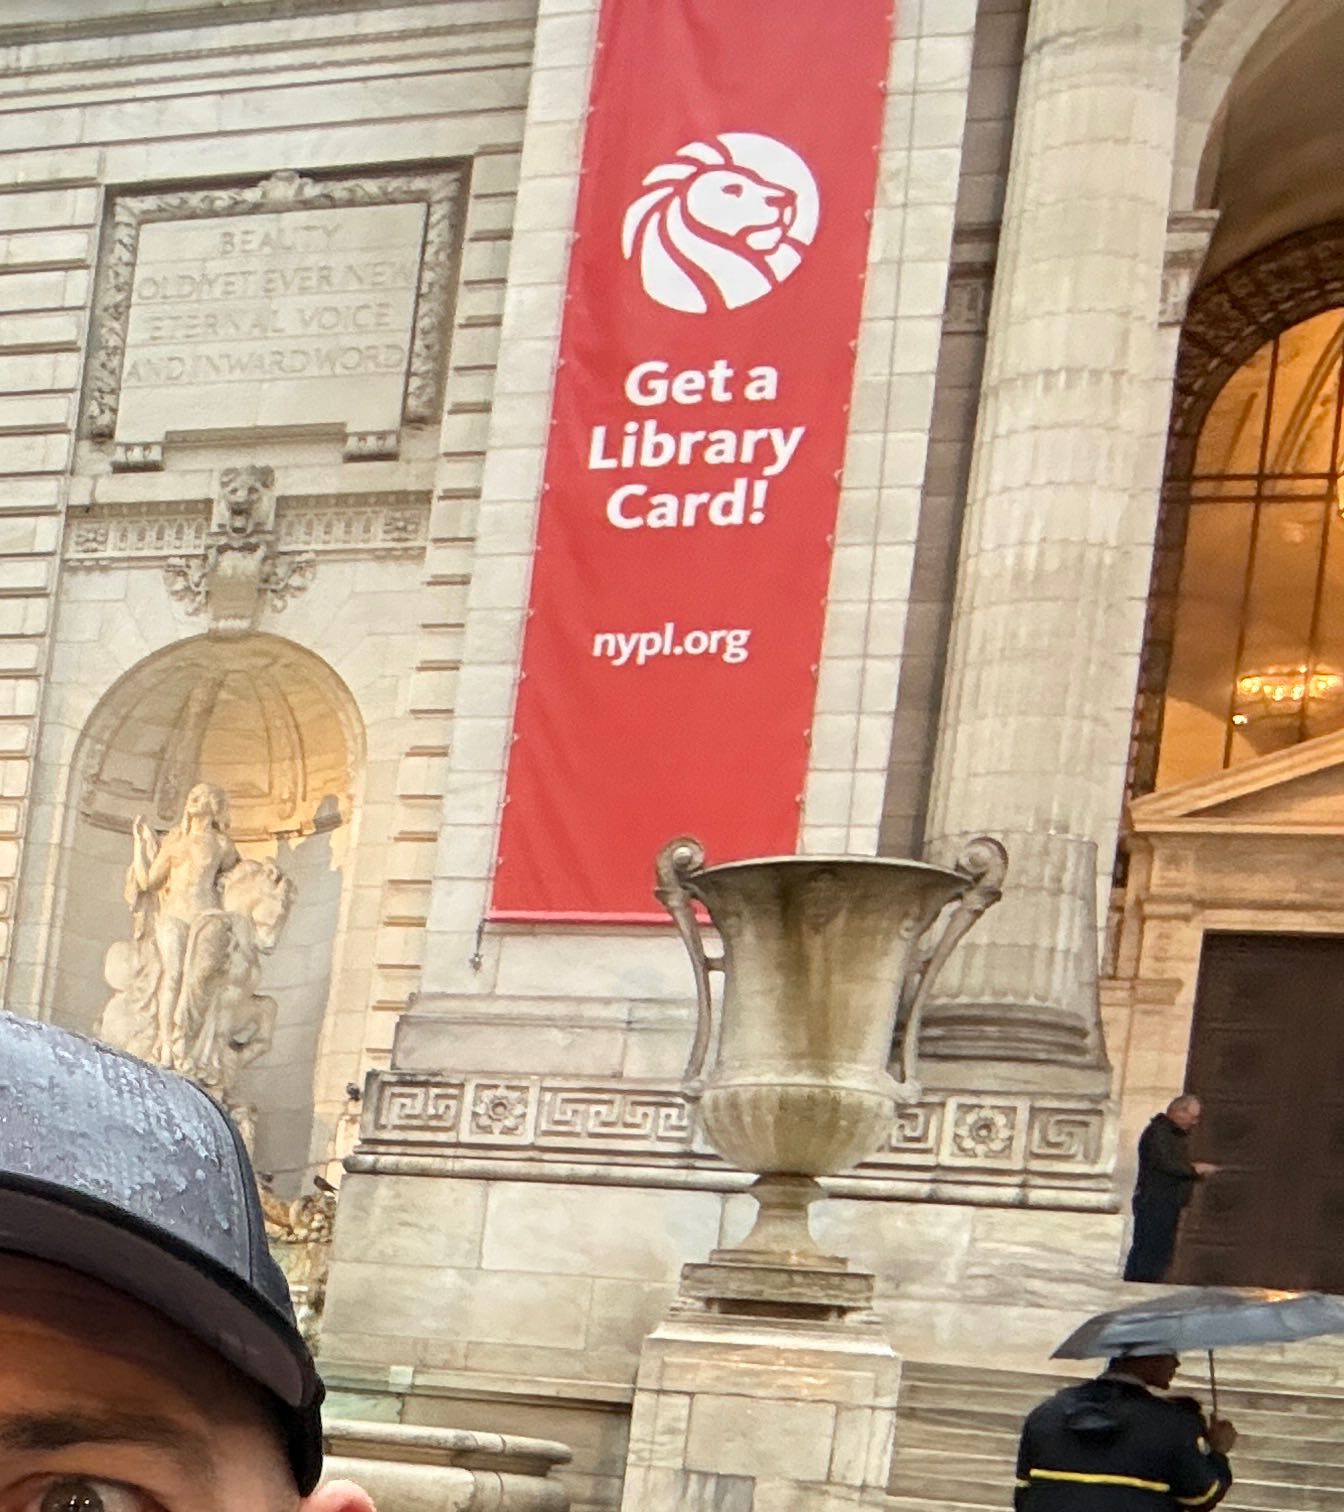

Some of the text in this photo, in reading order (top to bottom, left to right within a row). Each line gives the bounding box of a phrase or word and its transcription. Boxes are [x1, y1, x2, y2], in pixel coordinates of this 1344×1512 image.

[136, 273, 196, 301] OLD
[263, 264, 336, 294] EVER
[298, 302, 392, 332] VOICE
[624, 359, 778, 406] Get a
[588, 419, 805, 476] Library
[606, 477, 769, 528] Card!
[592, 622, 751, 666] nypl.org
